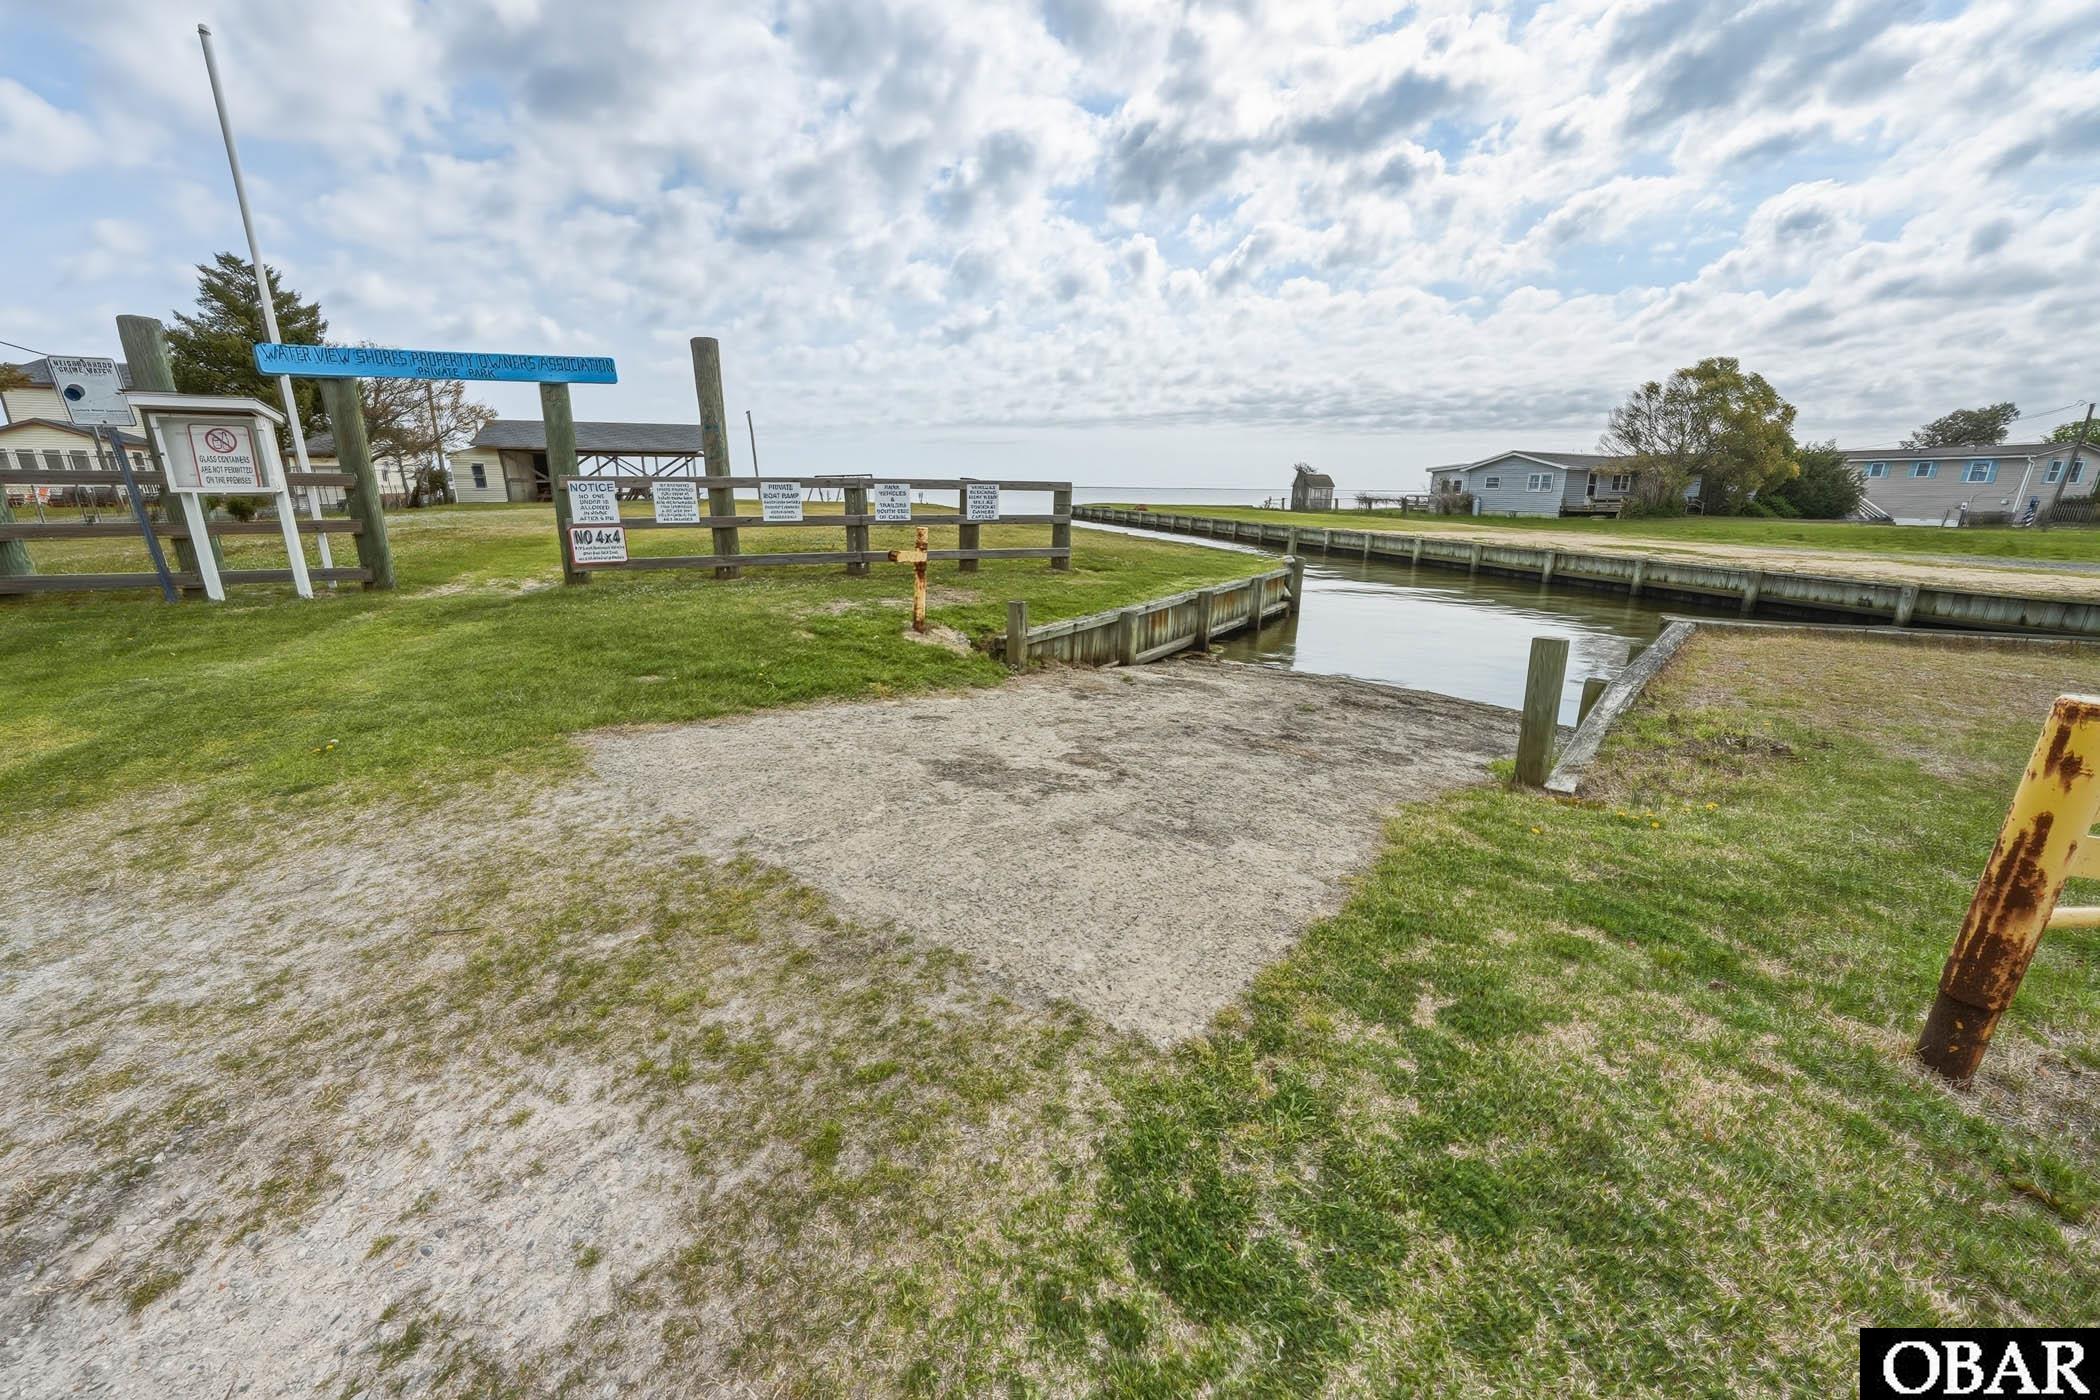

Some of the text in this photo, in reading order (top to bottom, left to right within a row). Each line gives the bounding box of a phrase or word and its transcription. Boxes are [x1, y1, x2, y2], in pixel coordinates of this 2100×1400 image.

[262, 345, 617, 373] WATER VIEW SHORES PROPERTY OWNERS ASSOCIATION
[417, 367, 496, 378] PRIVATE PARK
[199, 455, 250, 464] GLASS CONTAINERS
[224, 466, 253, 474] PERMITTED
[569, 483, 615, 492] NOTICE
[574, 530, 621, 545] NO 4x4
